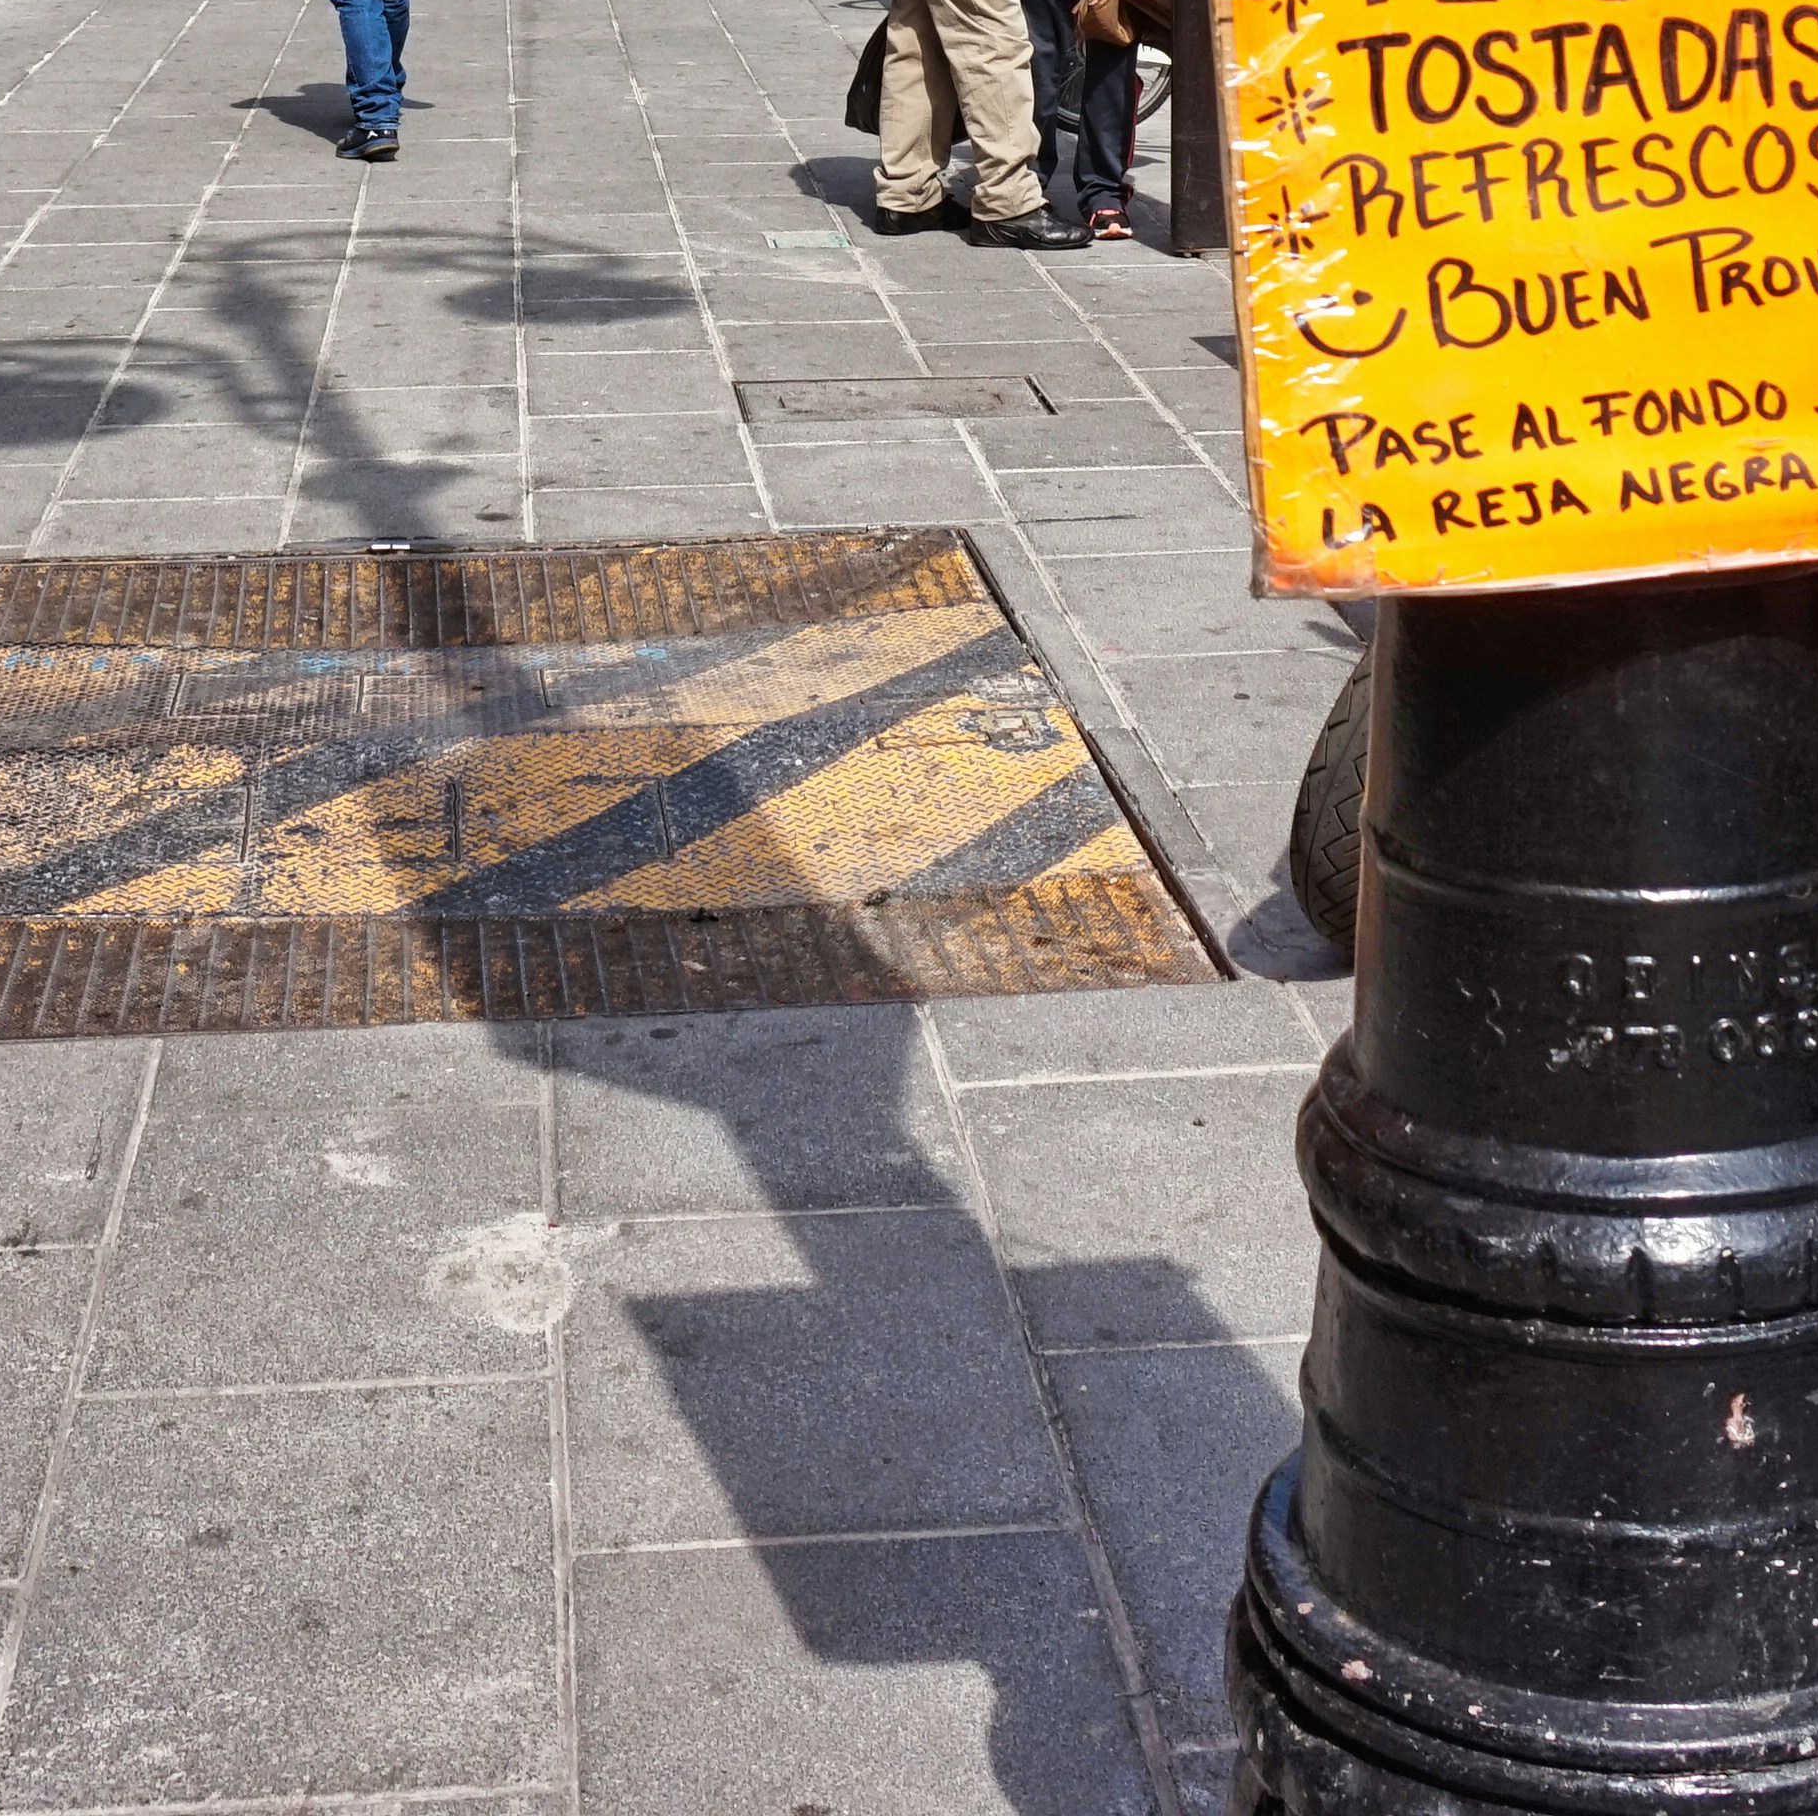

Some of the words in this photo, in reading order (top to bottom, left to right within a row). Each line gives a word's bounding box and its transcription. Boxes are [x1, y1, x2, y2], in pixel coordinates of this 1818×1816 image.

[1428, 259, 1648, 348] BUEN
[1300, 414, 1481, 475] PASE
[1512, 404, 1574, 450] AL
[1583, 380, 1786, 435] FONDO
[1323, 504, 1395, 549] LA
[1433, 480, 1589, 534] REJA
